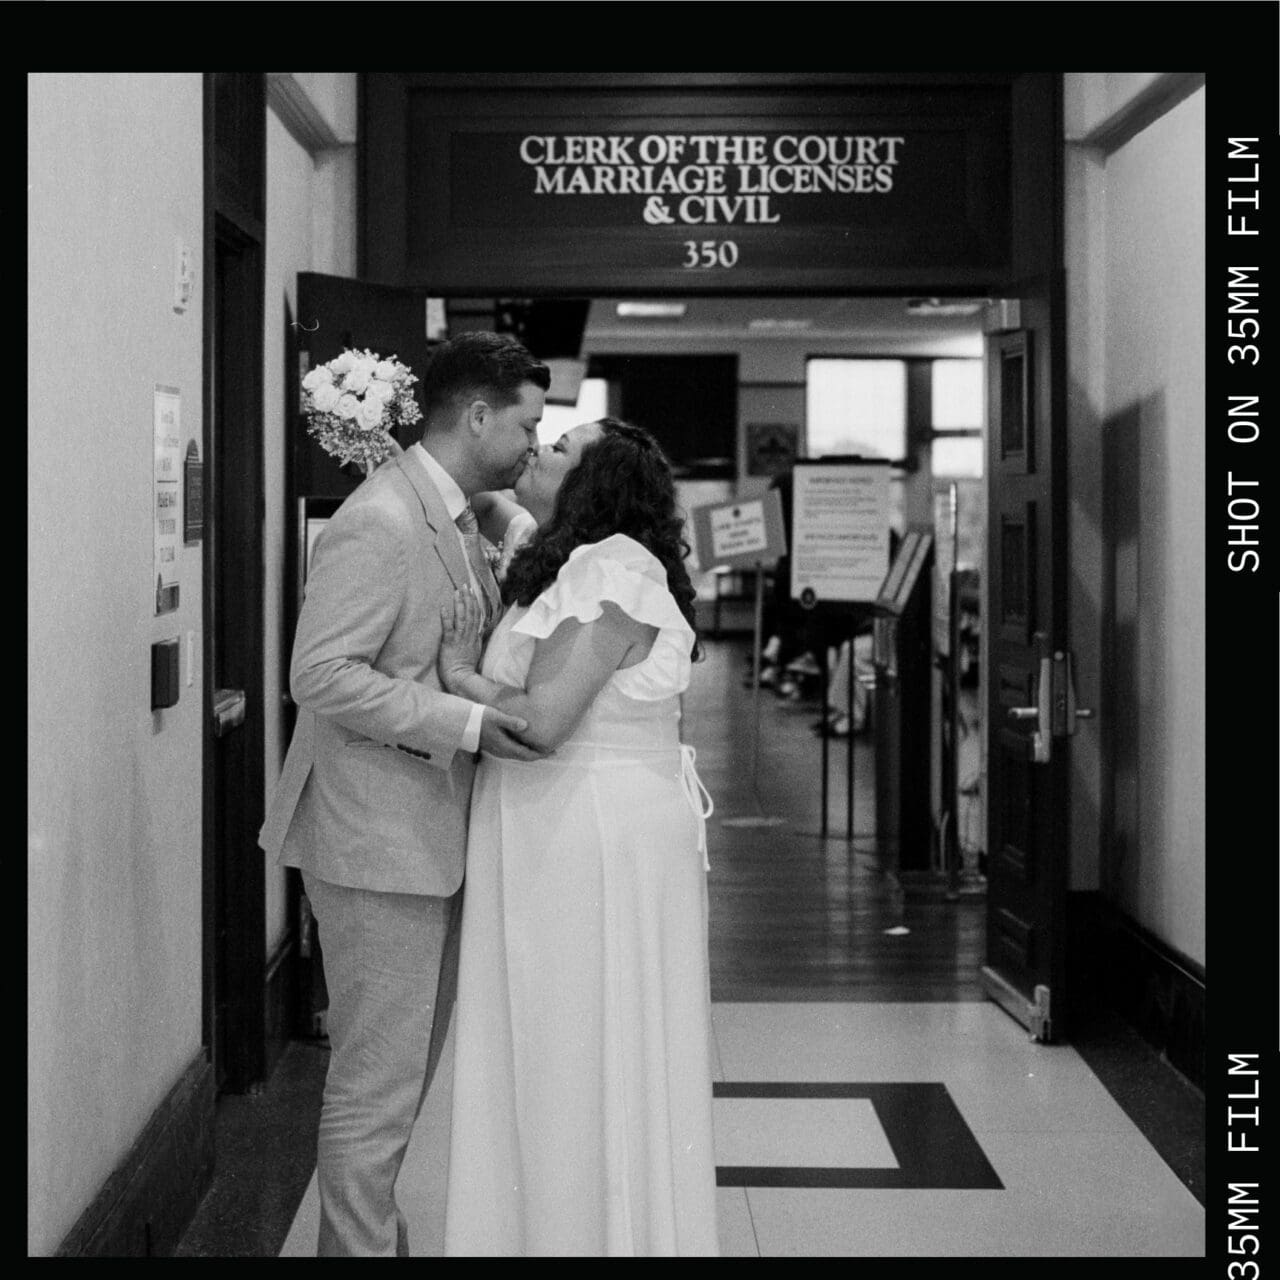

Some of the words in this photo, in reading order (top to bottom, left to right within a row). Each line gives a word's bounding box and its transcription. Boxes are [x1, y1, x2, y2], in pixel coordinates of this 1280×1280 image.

[520, 135, 635, 165] CLERK
[638, 135, 688, 165] OF
[690, 135, 767, 165] THE
[773, 135, 905, 166] COURT
[534, 165, 726, 194] MARRIAGE
[738, 165, 893, 194] LICENSES
[642, 195, 675, 225] &
[678, 195, 781, 224] CIVIL
[682, 240, 739, 268] 350
